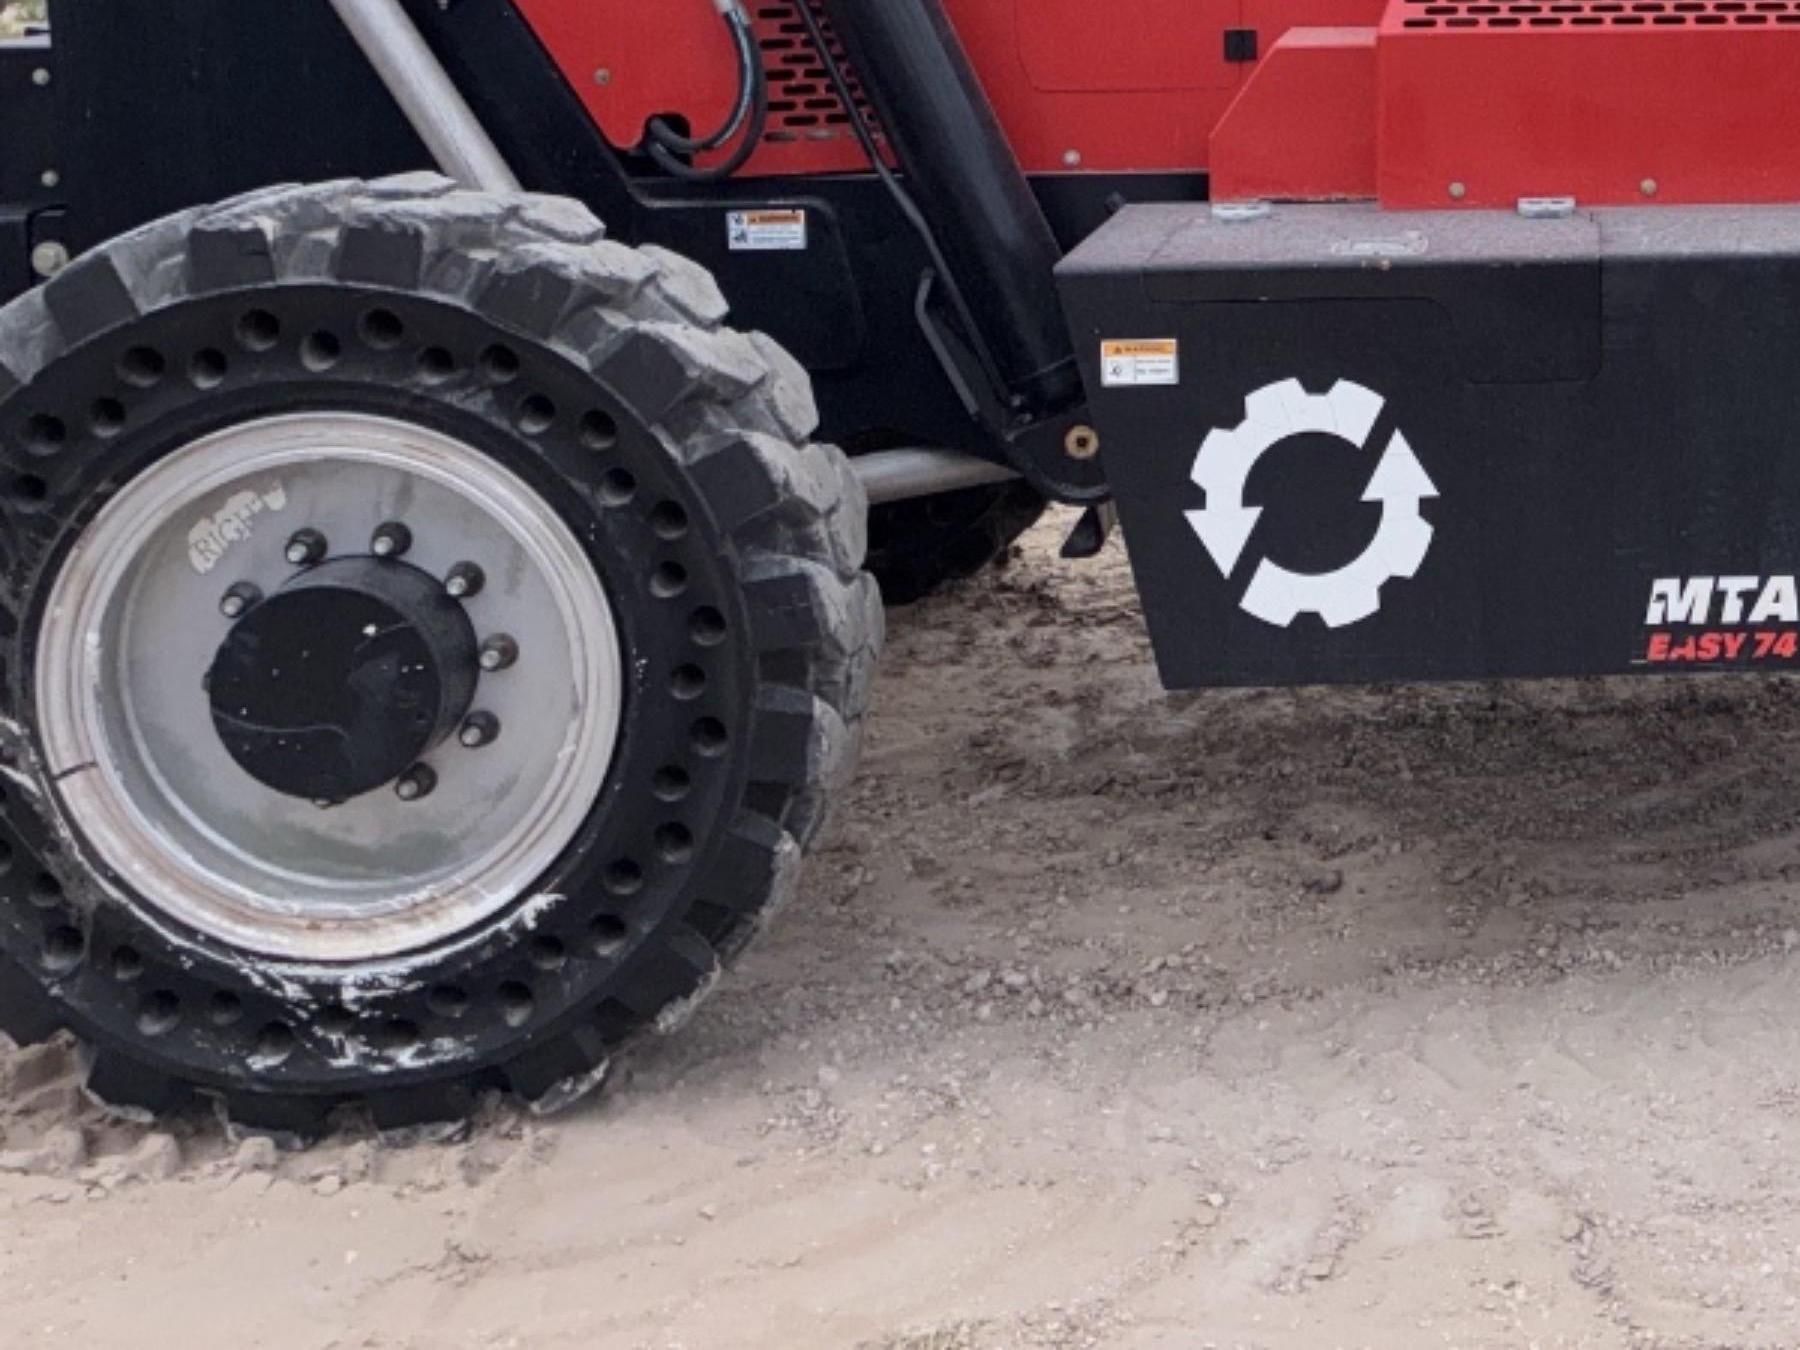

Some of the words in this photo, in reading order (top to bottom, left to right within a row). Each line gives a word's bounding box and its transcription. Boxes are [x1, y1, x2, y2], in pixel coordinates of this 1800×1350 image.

[1645, 575, 1800, 624] MTA
[1646, 631, 1748, 661] EASY
[1753, 630, 1799, 658] 74
